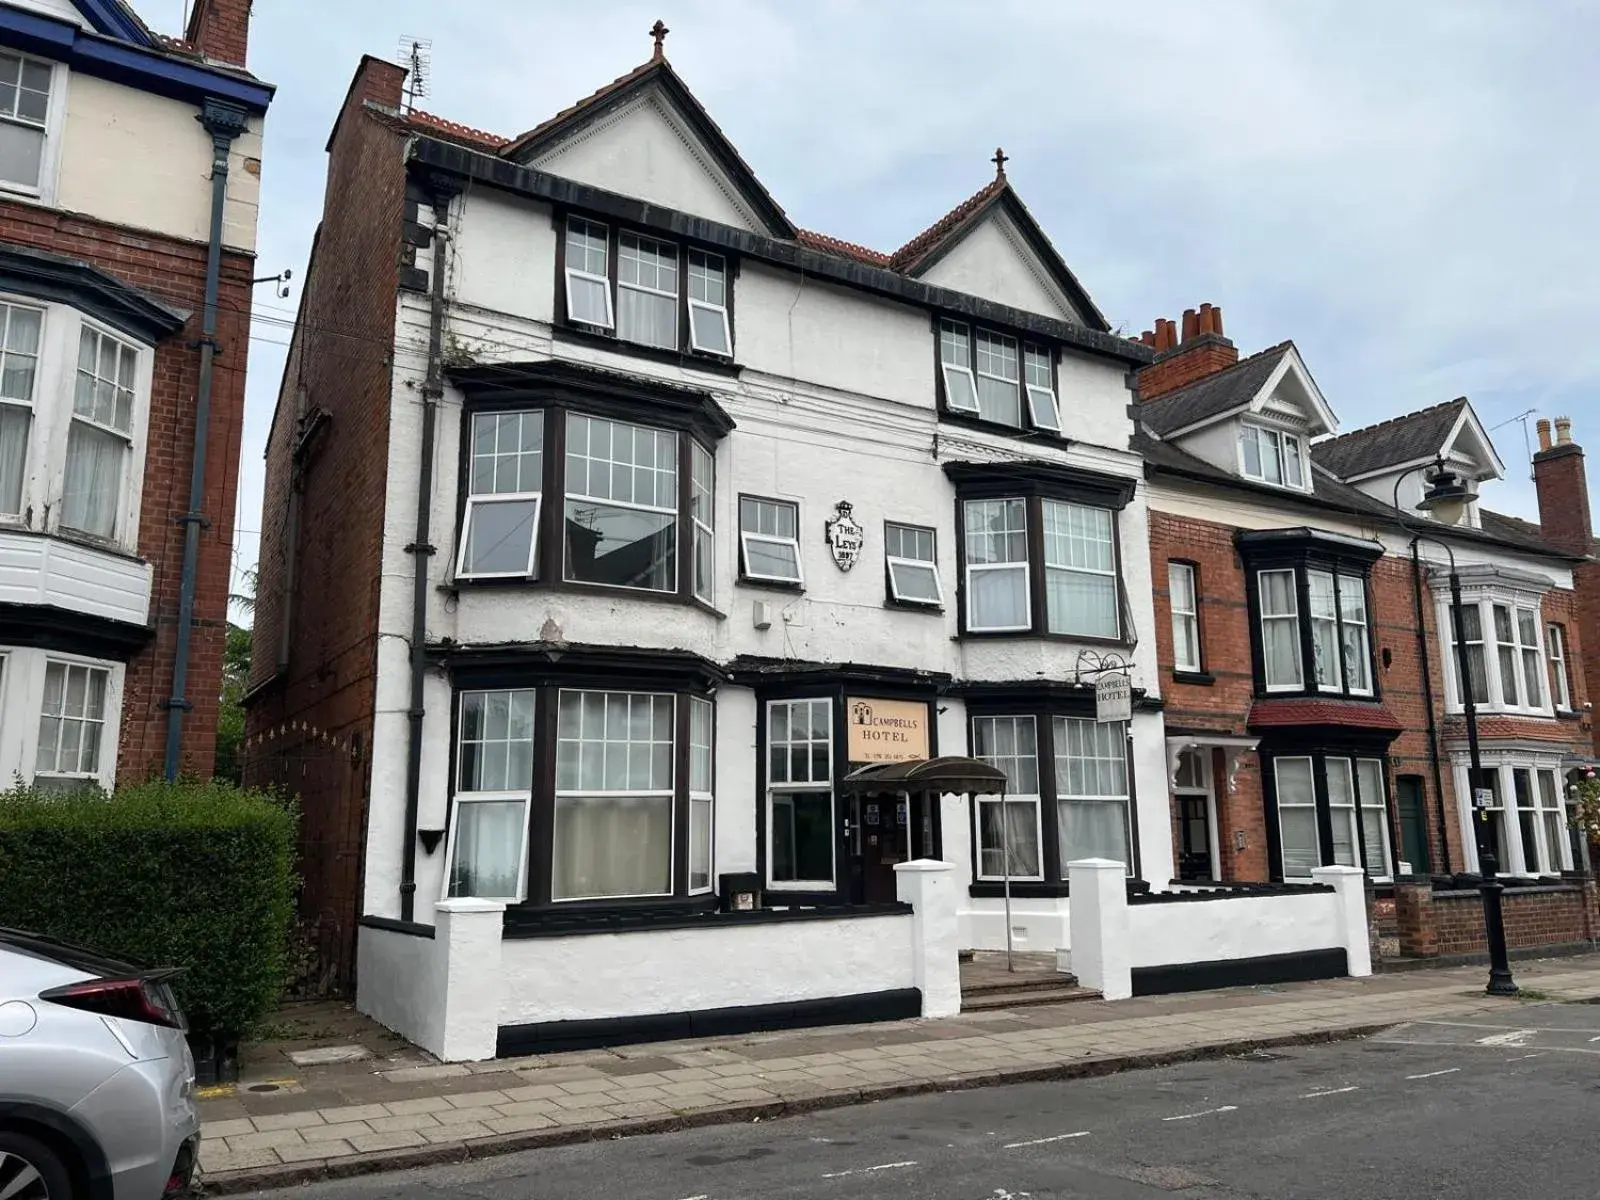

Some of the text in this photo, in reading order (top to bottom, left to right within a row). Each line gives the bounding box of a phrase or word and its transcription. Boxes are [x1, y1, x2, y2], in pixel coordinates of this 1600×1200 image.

[837, 524, 855, 536] THE
[835, 534, 857, 551] LEYS
[1096, 678, 1130, 690] CAMPBELLS
[1097, 690, 1128, 702] HOTEL
[873, 717, 918, 729] CAMPBELLS
[862, 730, 909, 742] HOTEL
